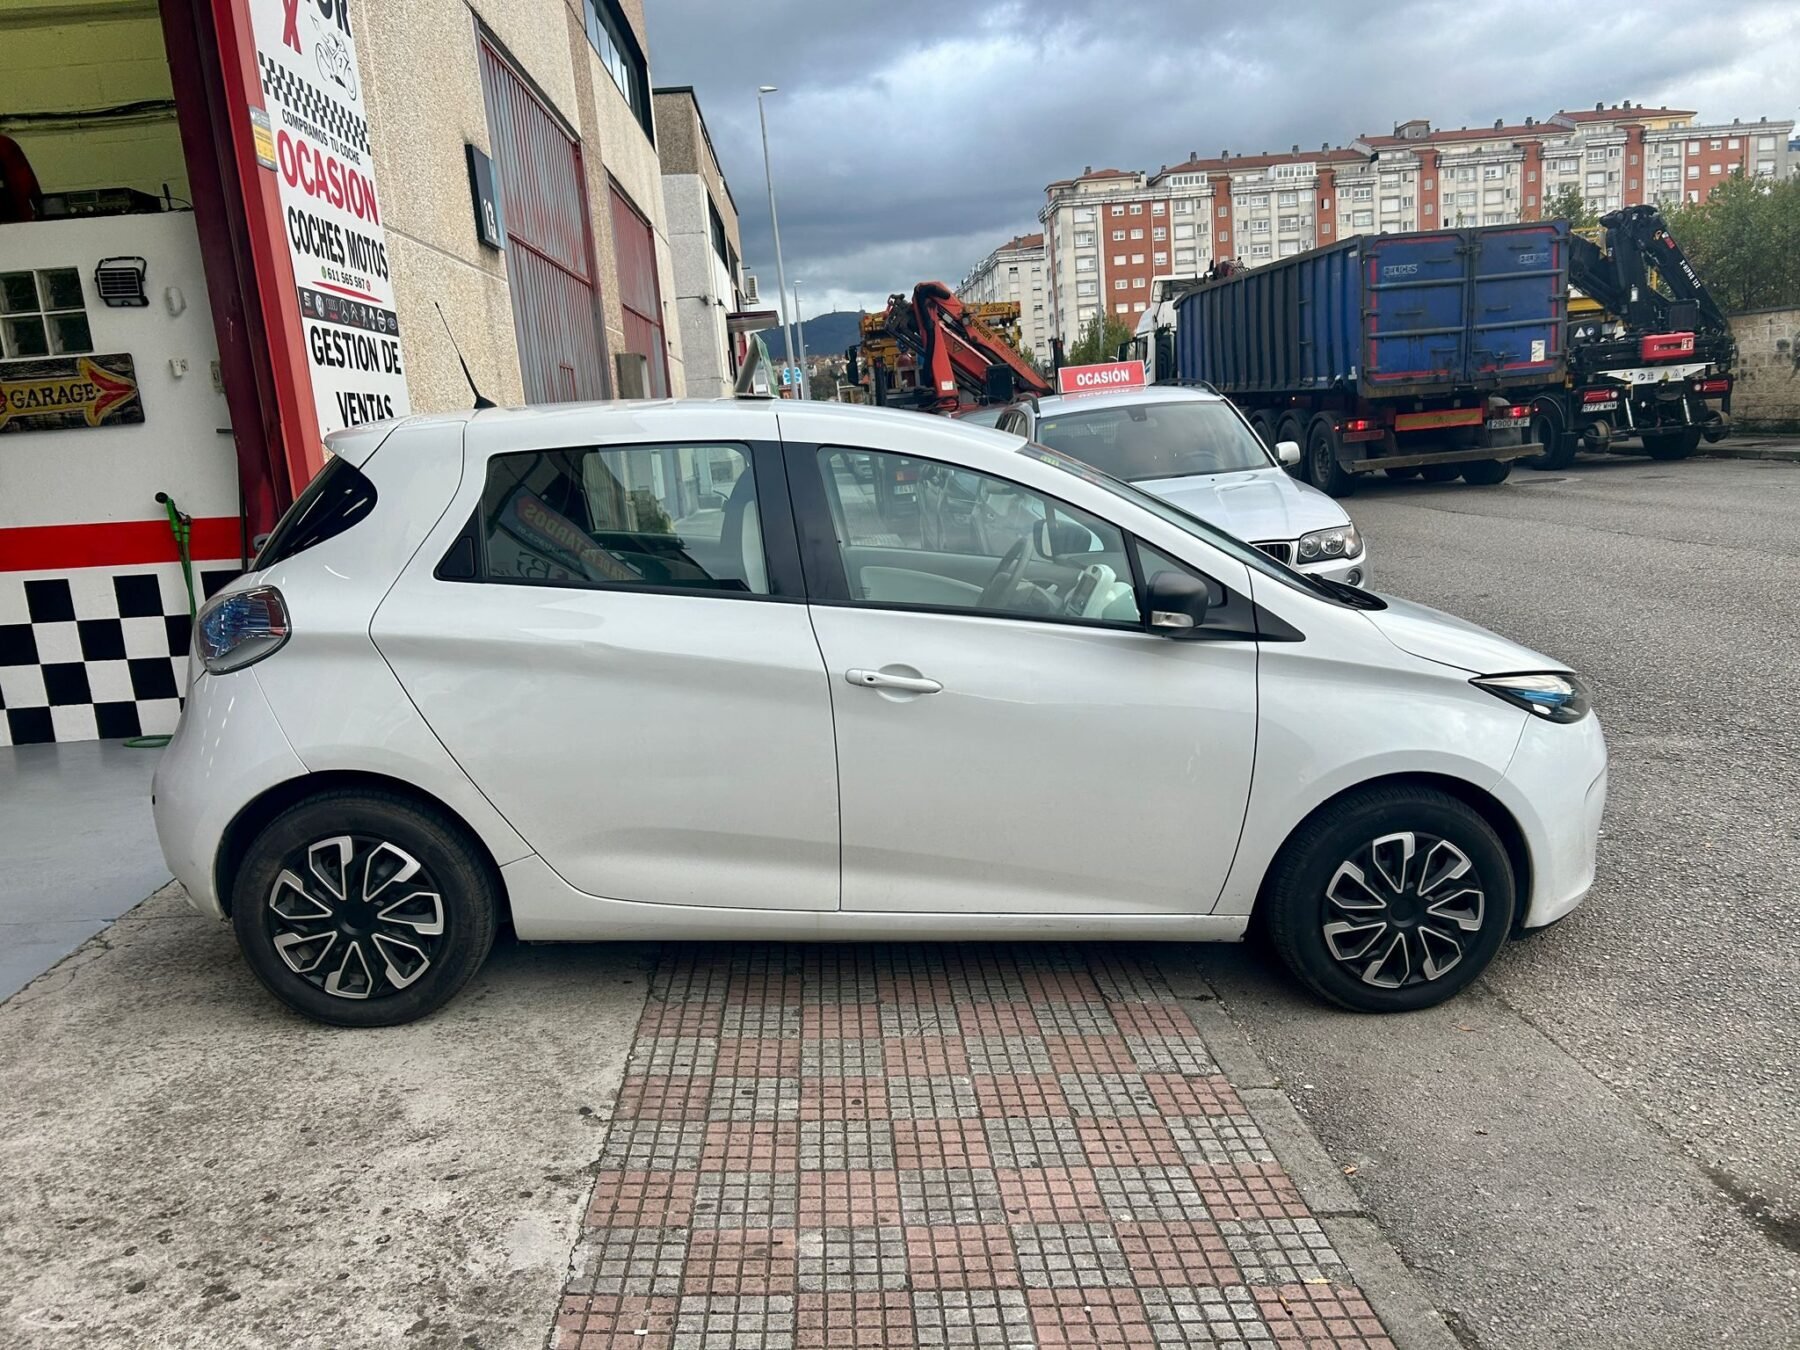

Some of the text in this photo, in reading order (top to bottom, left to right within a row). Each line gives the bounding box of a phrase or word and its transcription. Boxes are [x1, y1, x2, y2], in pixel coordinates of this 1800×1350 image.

[282, 108, 329, 148] COMPRAMOS
[330, 134, 340, 154] TU
[340, 143, 361, 166] COCHE
[277, 129, 379, 227] OCASION
[287, 205, 389, 282] COCHES MOTOS
[327, 267, 365, 290] 611 565 587
[310, 325, 402, 375] GESTION DE
[10, 382, 97, 409] GARAGE
[1076, 367, 1130, 386] OCASIÓN
[336, 391, 395, 428] VENTAS
